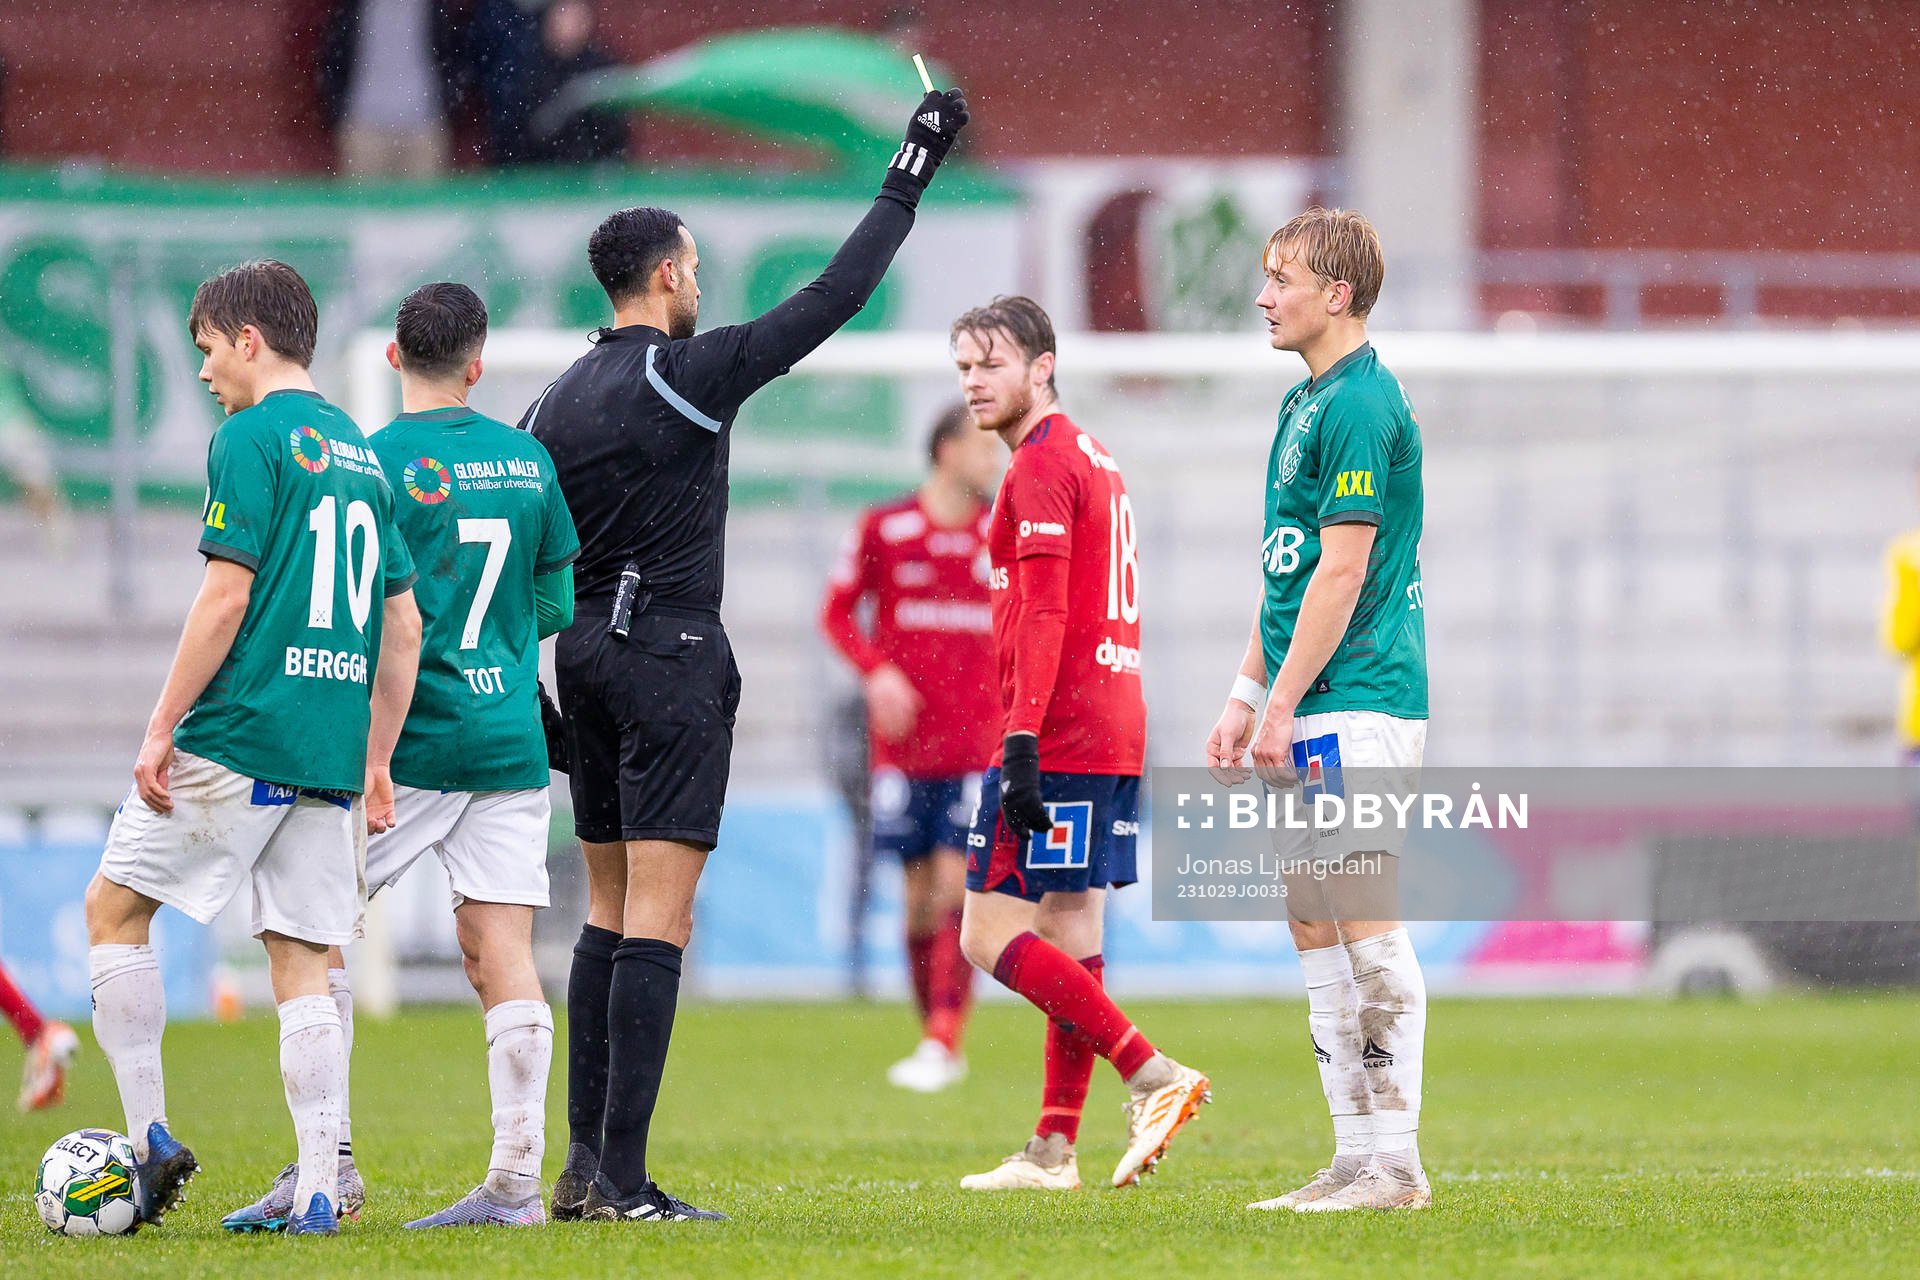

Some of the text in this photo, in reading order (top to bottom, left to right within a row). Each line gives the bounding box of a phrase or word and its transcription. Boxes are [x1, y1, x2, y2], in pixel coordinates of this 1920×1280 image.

[917, 115, 941, 133] adidas
[329, 438, 367, 463] GLOBALA
[453, 457, 540, 479] GLOBALA MÅLEN
[458, 478, 543, 493] för hållbar utveckling
[1335, 470, 1374, 498] XXL
[308, 495, 380, 634] 10
[1106, 491, 1140, 624] 18
[457, 518, 512, 650] 7
[463, 666, 505, 695] TOT
